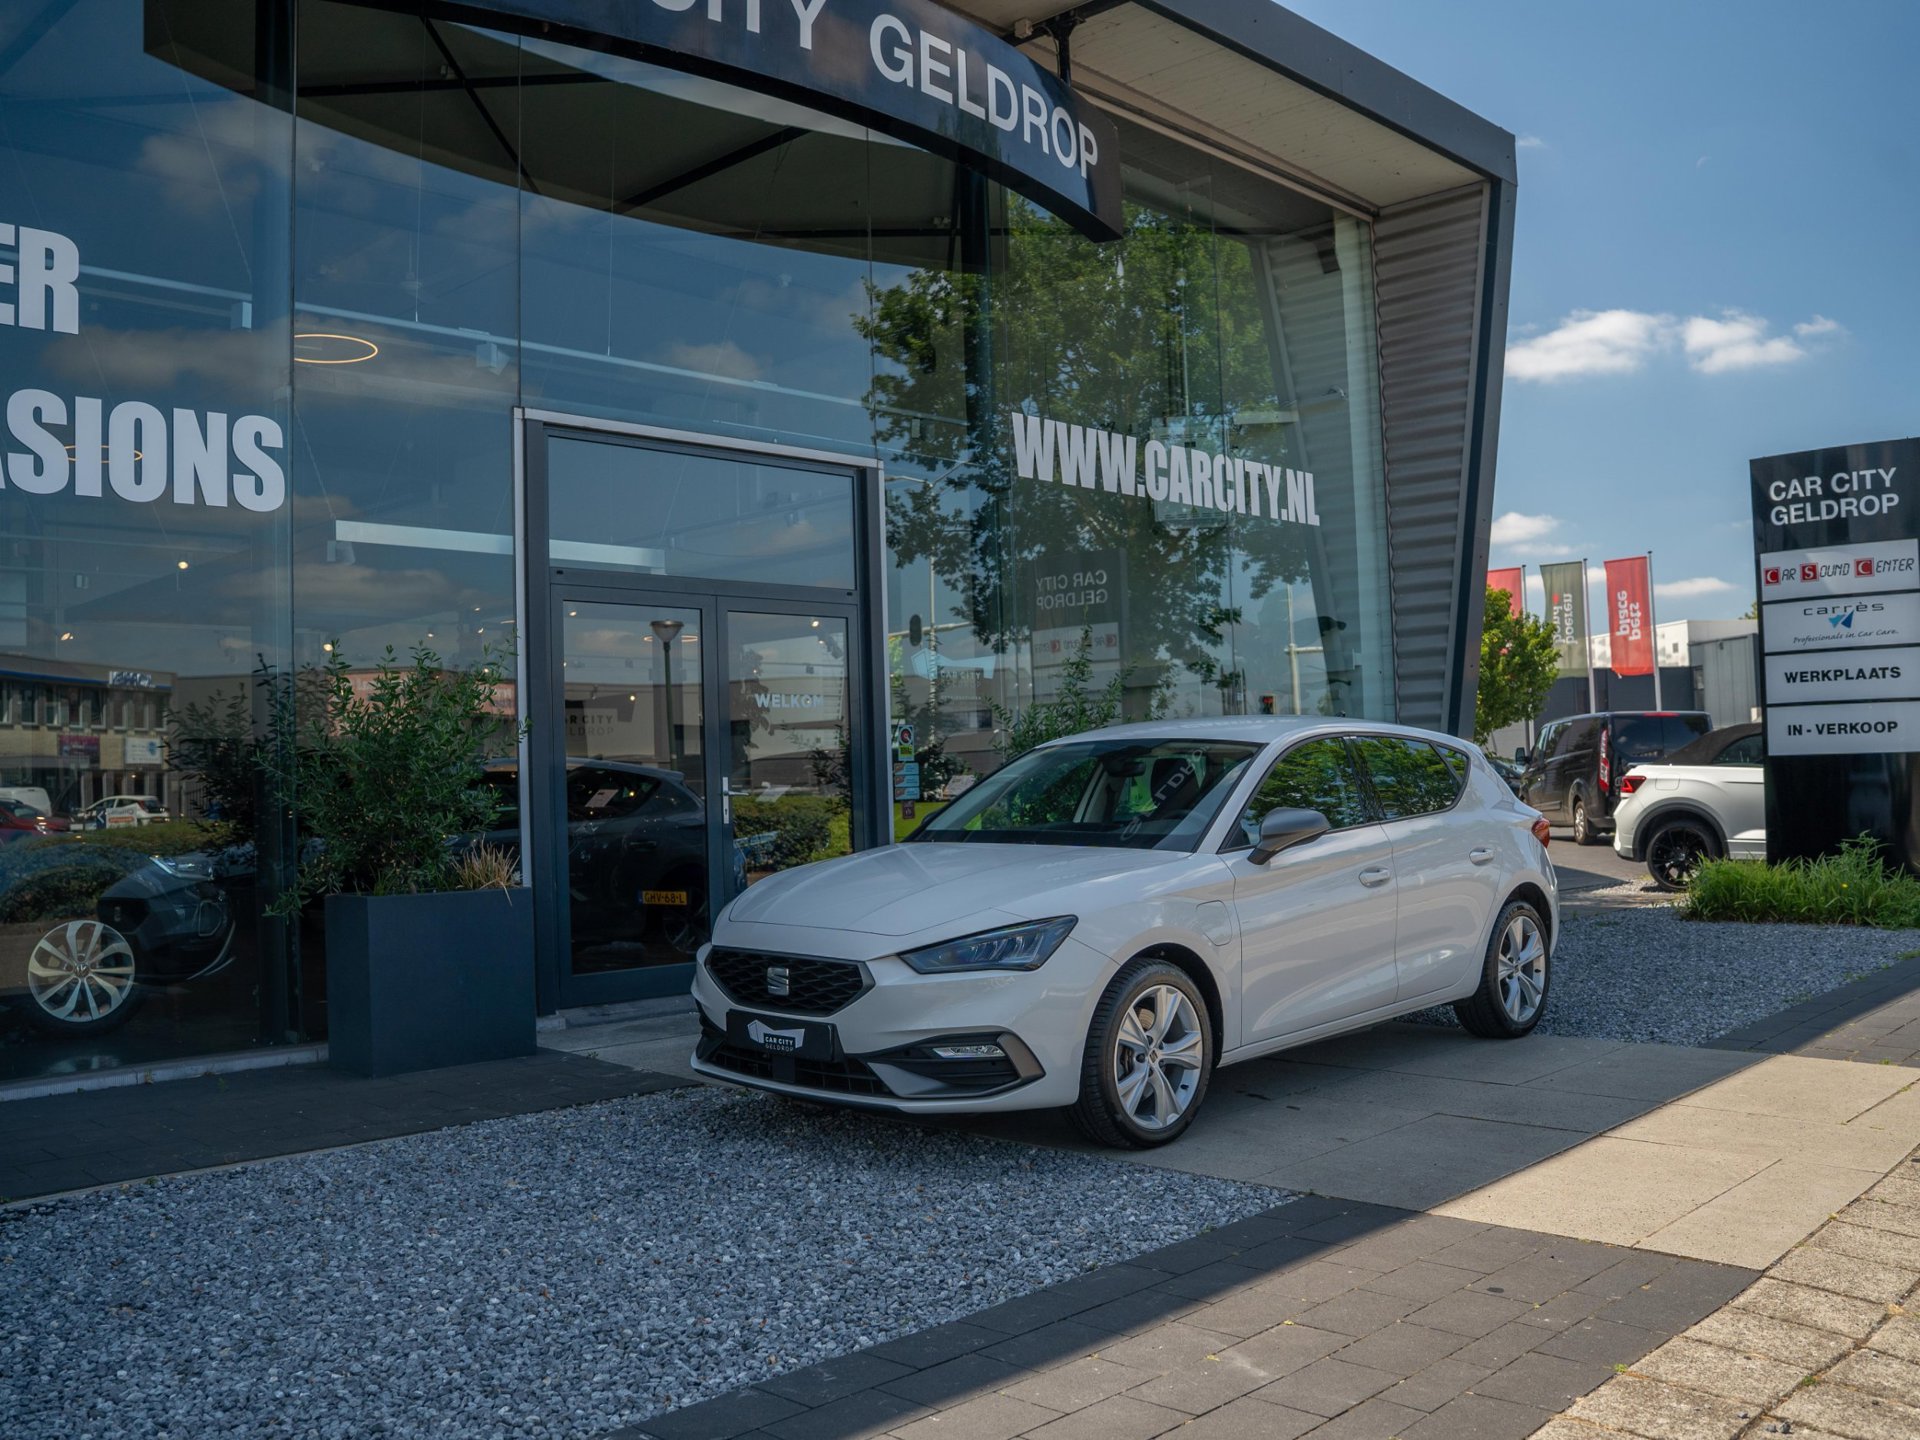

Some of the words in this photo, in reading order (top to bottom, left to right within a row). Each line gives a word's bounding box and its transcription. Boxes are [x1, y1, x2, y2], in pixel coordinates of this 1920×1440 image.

[869, 13, 1098, 181] GELDROP
[0, 388, 286, 512] SIONS
[1011, 411, 1321, 527] WWW.CARCITY.NL
[1769, 476, 1823, 501] CAR
[1830, 467, 1897, 493] CITY
[1770, 493, 1900, 526] GELDROP
[1765, 568, 1797, 584] CAR
[1803, 562, 1850, 580] SOUND
[1857, 558, 1915, 575] CENTER
[1803, 601, 1885, 616] carrès
[1845, 631, 1856, 639] in
[1858, 630, 1872, 638] Car
[1784, 666, 1902, 684] WERKPLAATS
